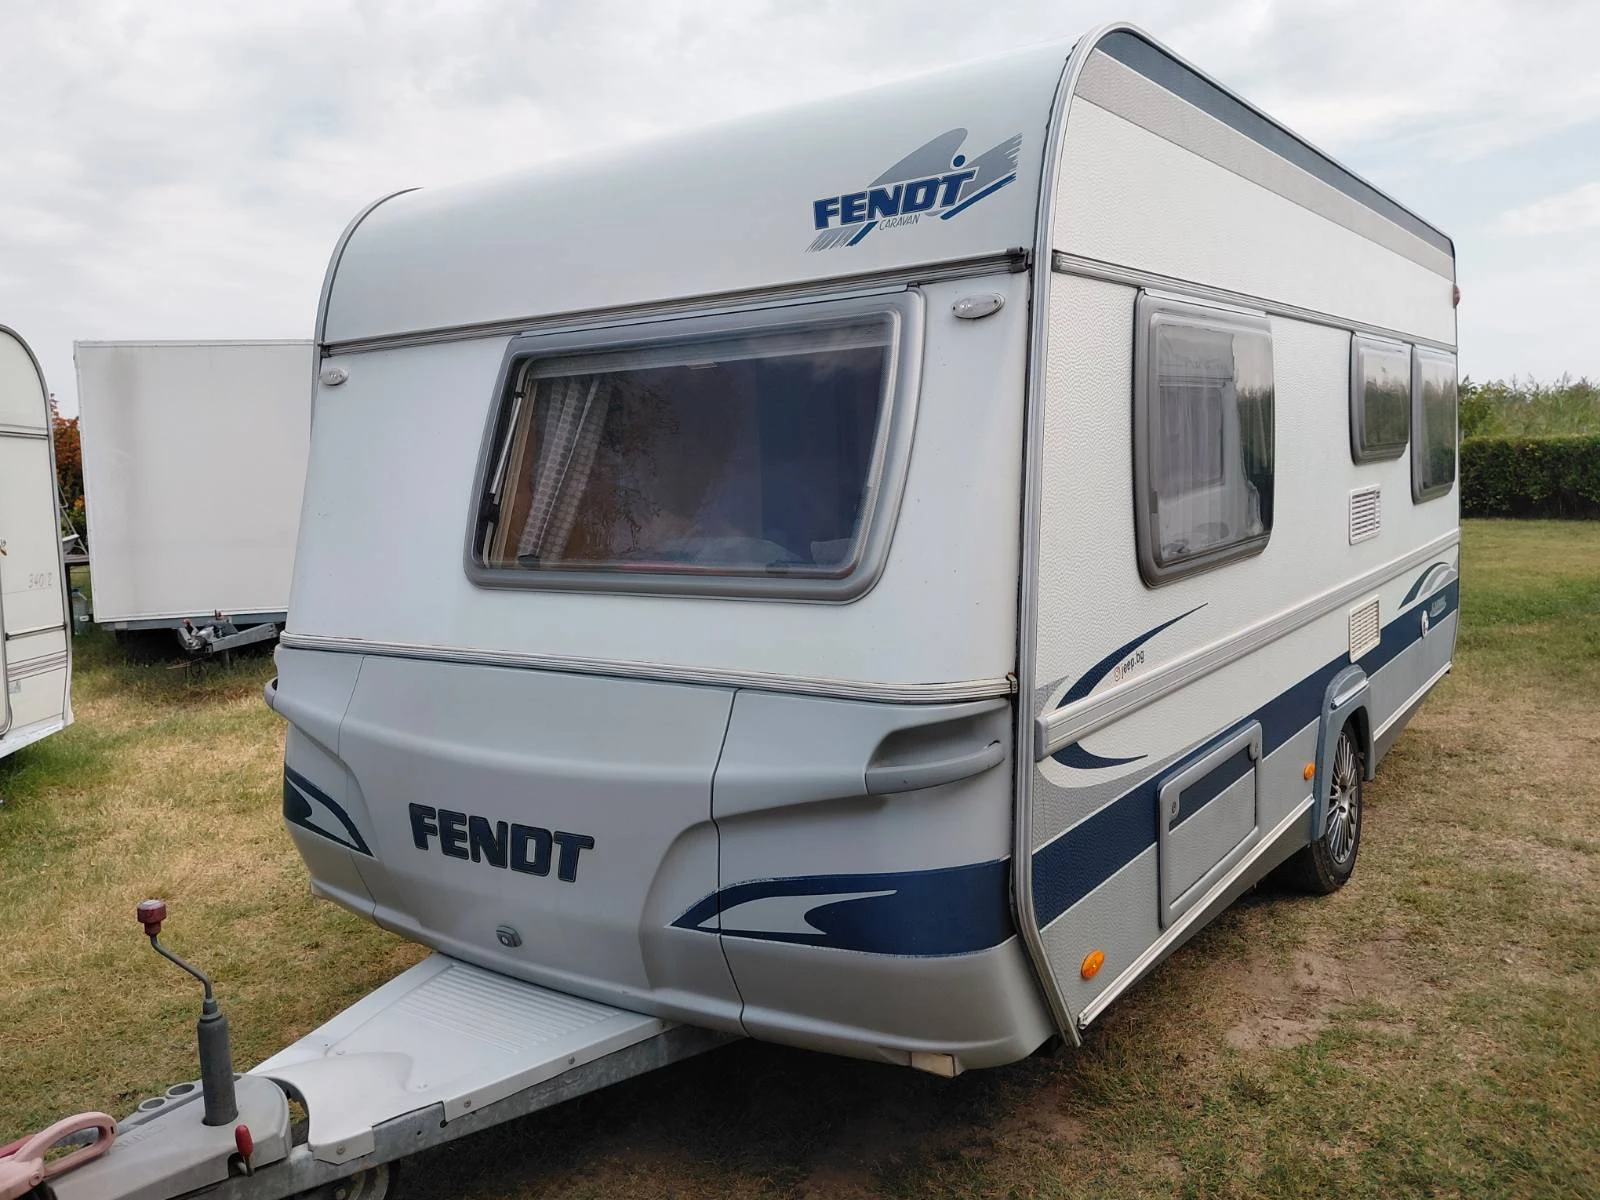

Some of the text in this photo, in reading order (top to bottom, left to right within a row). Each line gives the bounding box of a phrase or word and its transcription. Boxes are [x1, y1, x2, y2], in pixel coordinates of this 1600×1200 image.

[813, 168, 978, 230] FENDT
[879, 214, 920, 231] CARAVAN
[1120, 650, 1145, 679] jeep.bg
[408, 802, 595, 883] FENDT
